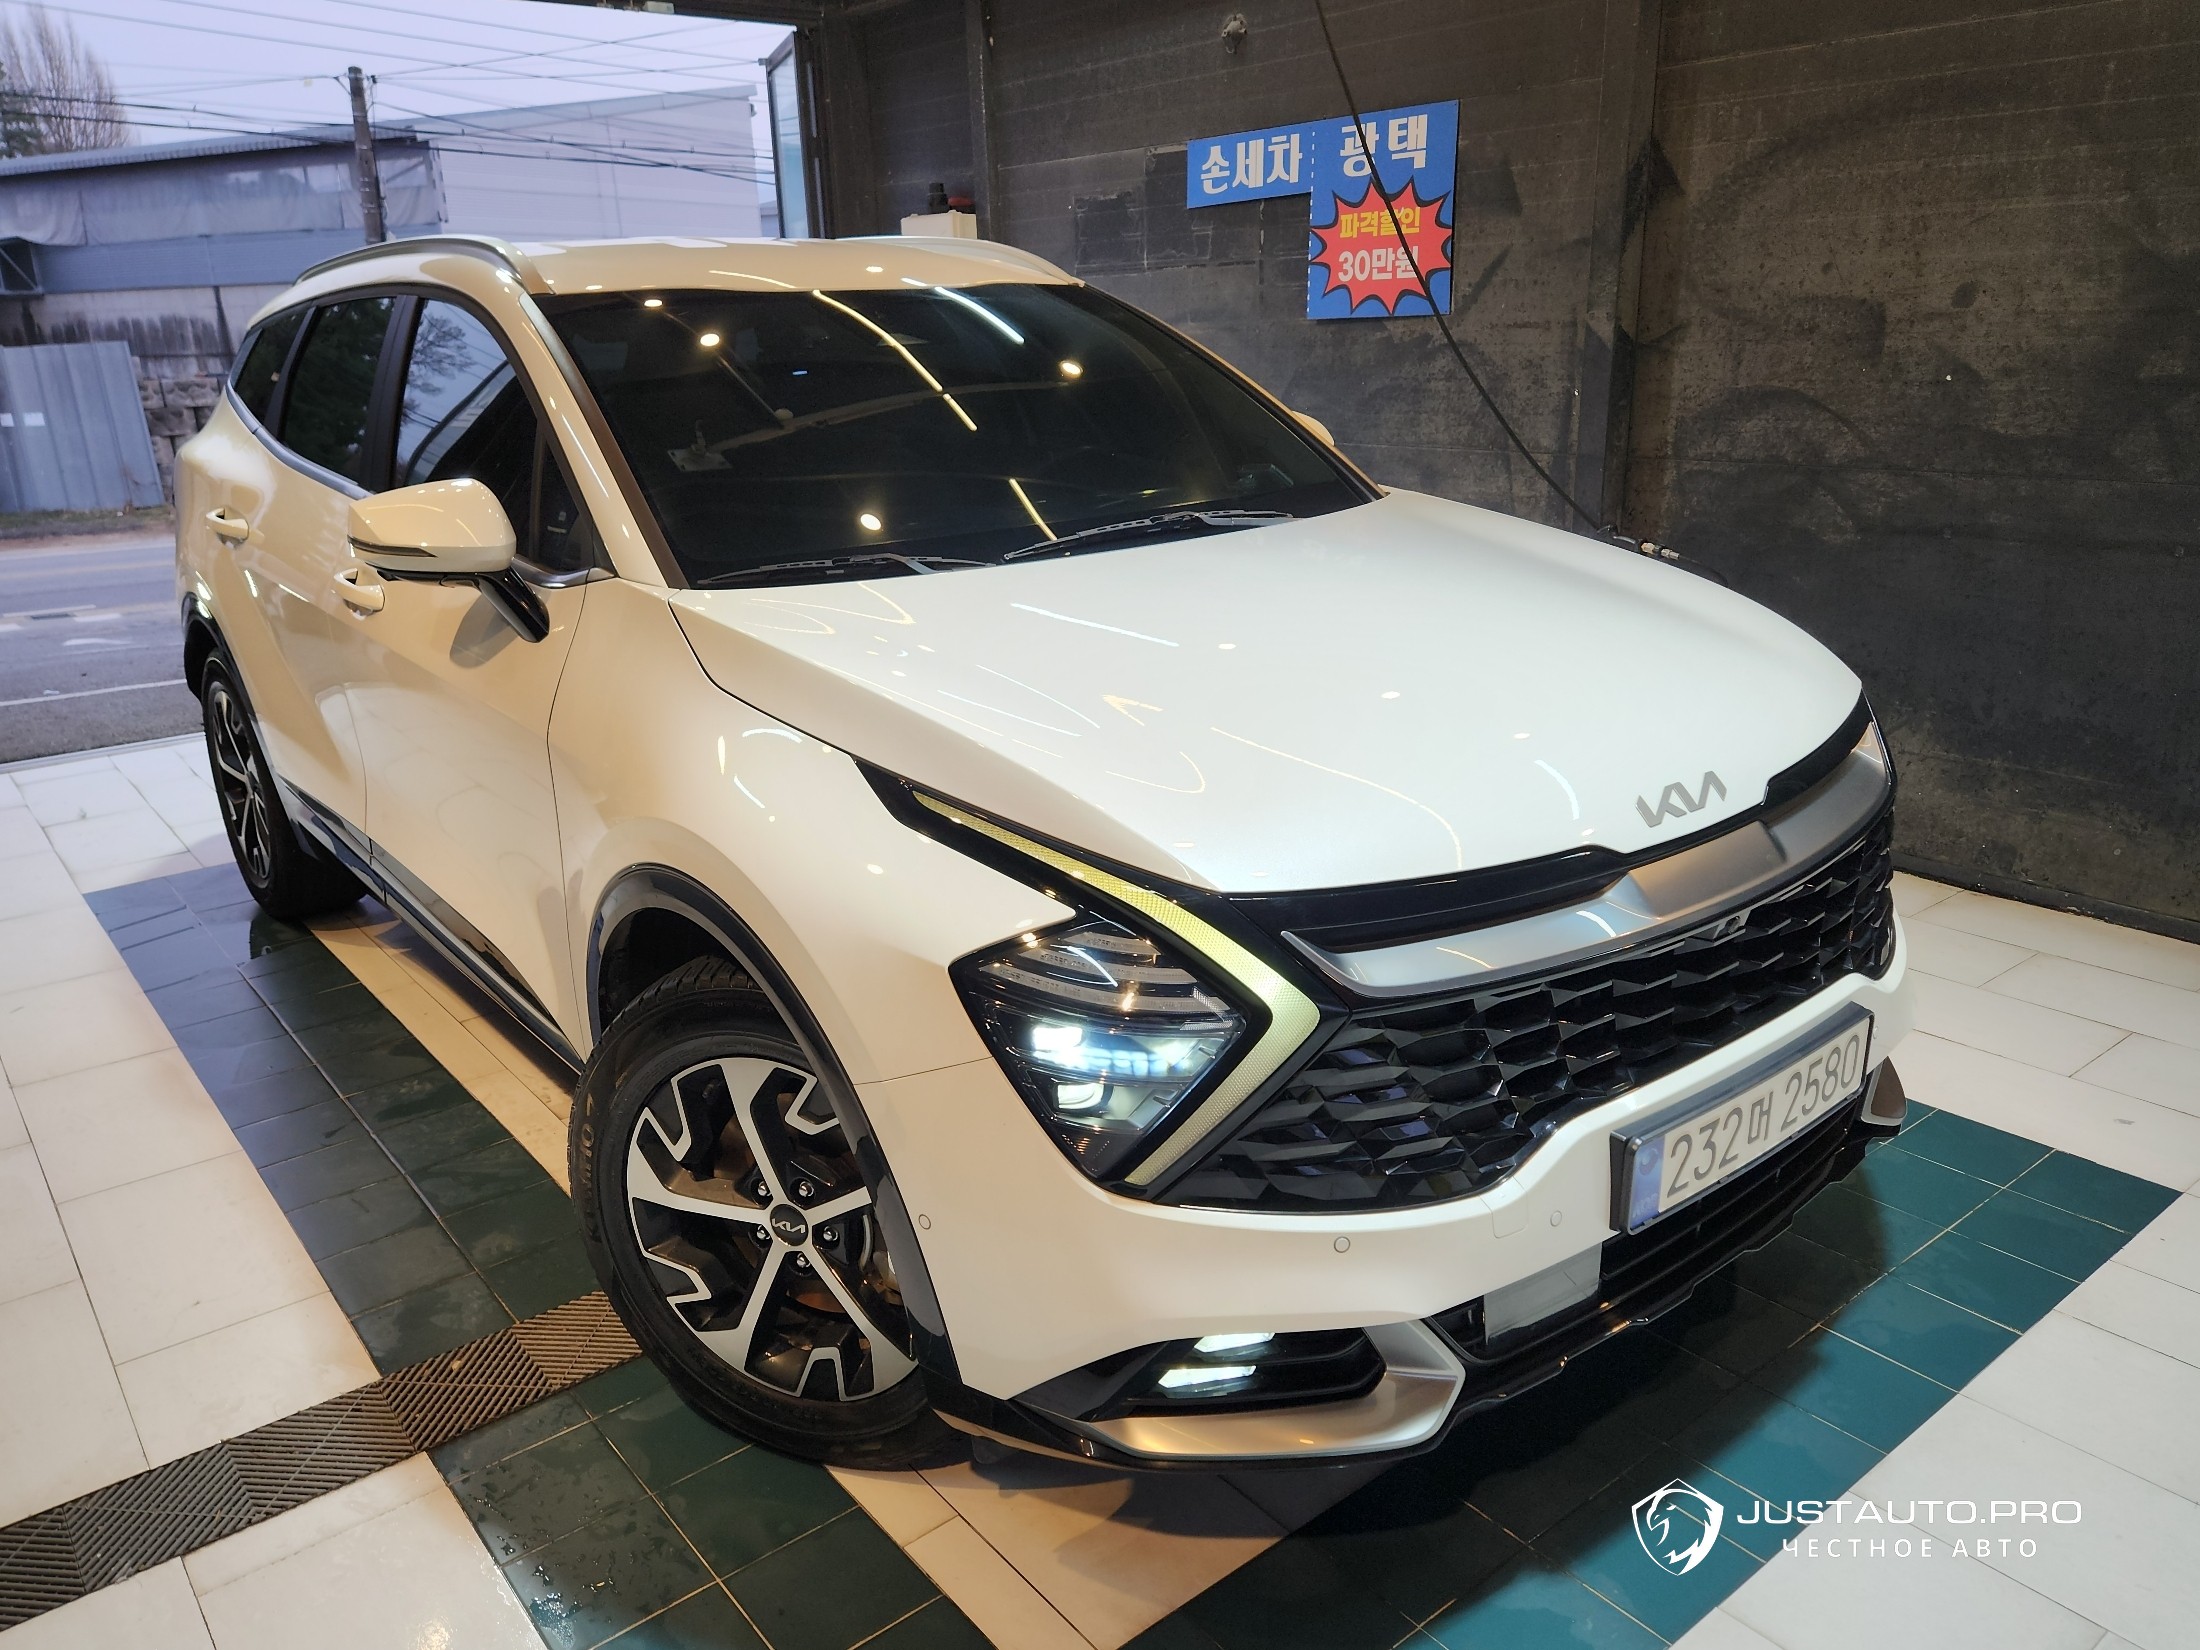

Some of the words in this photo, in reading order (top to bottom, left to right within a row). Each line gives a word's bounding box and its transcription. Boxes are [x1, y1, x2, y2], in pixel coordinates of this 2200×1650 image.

[1200, 133, 1302, 195] 손세차
[1339, 114, 1428, 177] 광택
[1338, 245, 1419, 282] 30만원
[1635, 770, 1727, 828] KIA
[1667, 1091, 1774, 1198] 232머
[1780, 1034, 1860, 1132] 2580
